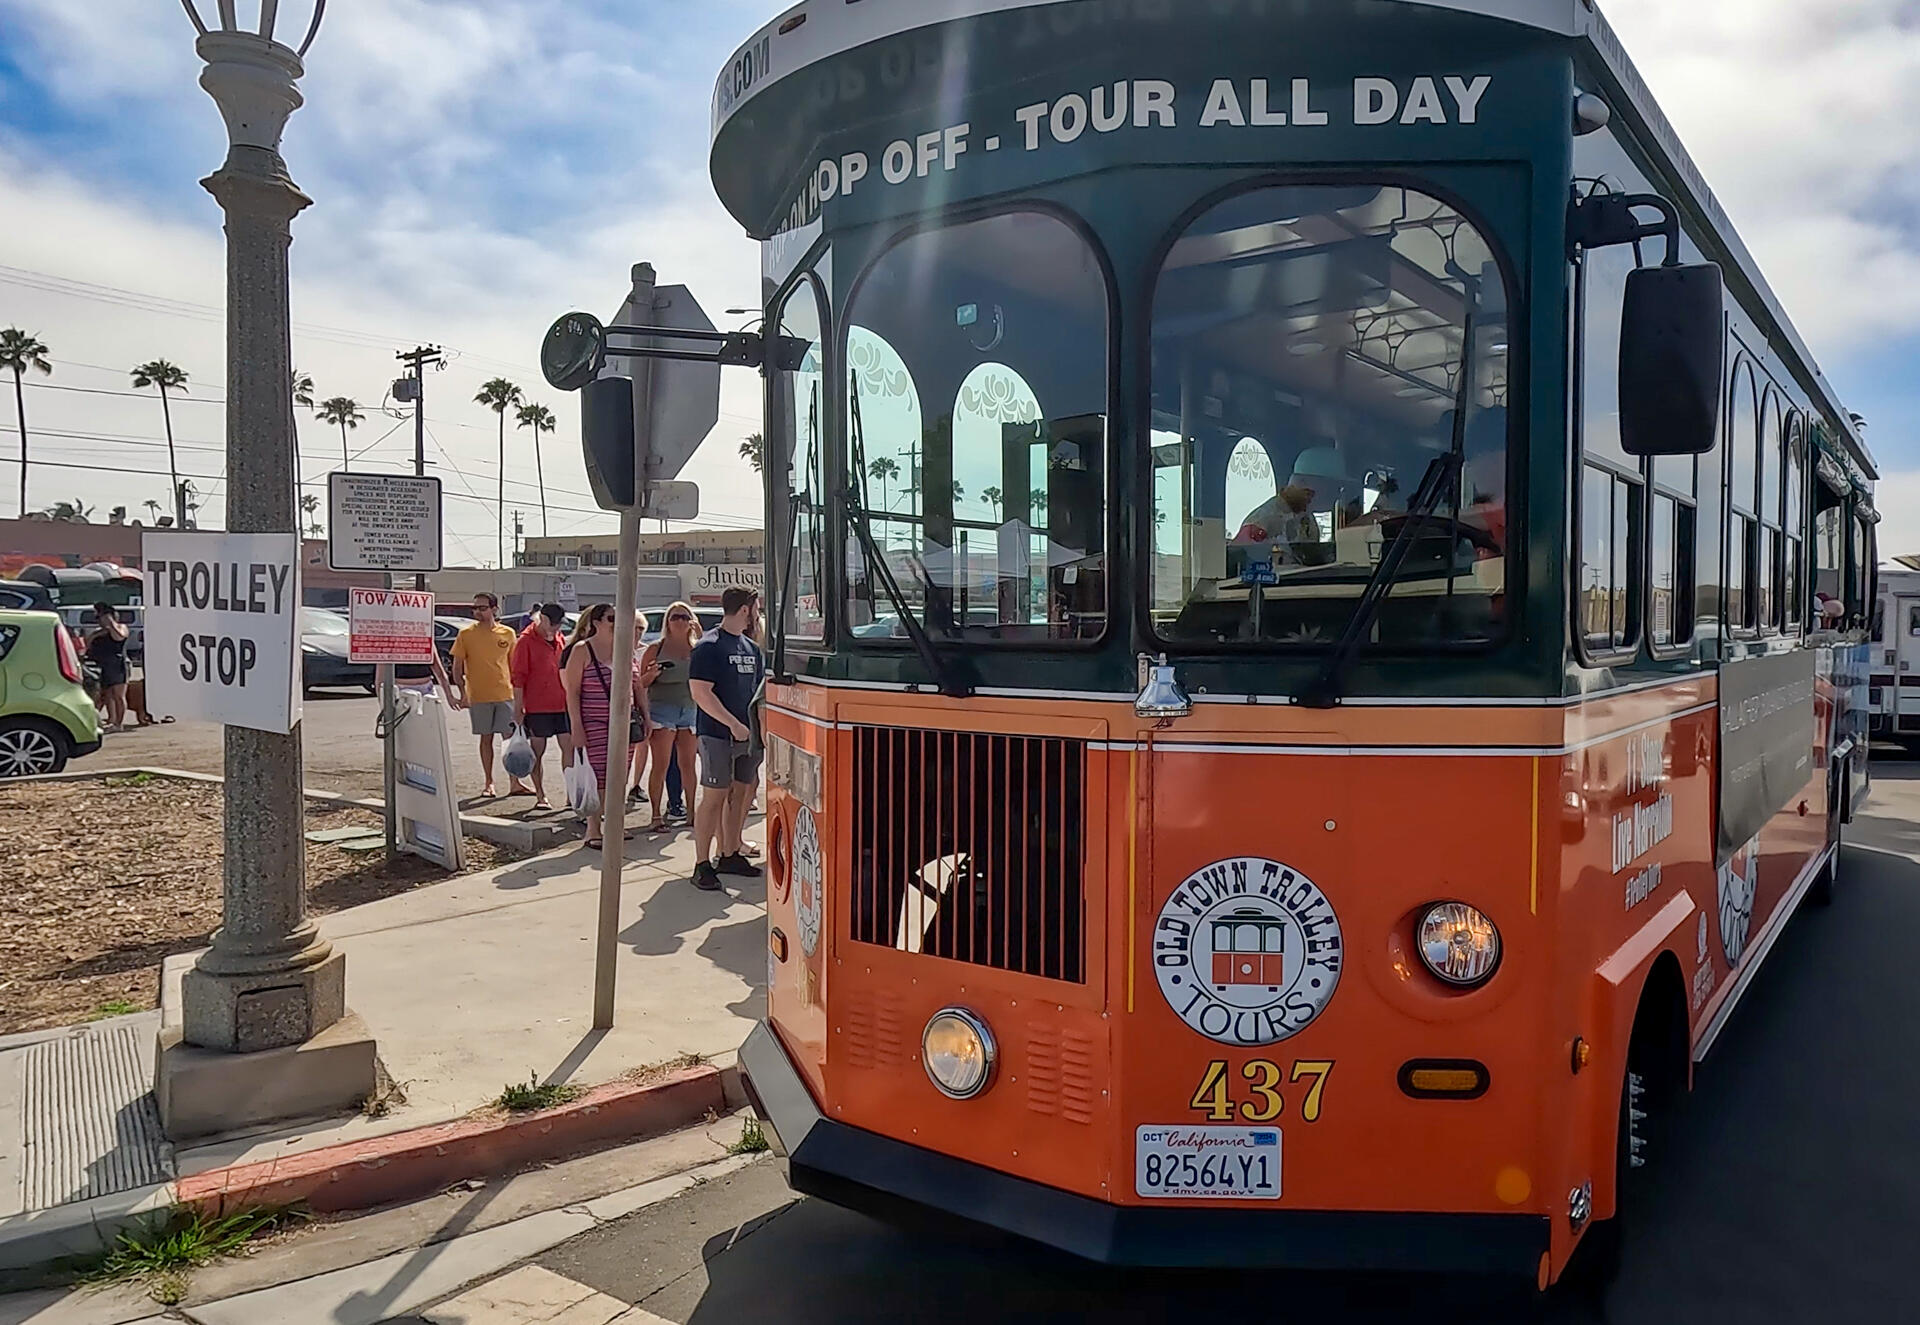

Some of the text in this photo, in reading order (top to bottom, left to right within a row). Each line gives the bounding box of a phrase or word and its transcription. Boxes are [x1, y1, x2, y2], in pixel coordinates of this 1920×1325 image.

[808, 152, 868, 216] HOP
[882, 122, 970, 185] OFF
[1015, 79, 1177, 151] TOUR
[1198, 78, 1329, 127] ALL
[1353, 76, 1492, 125] DAY
[147, 560, 290, 615] TROLLEY
[355, 592, 430, 608] TOW AWAY
[179, 633, 257, 687] STOP
[1626, 737, 1637, 796] 11
[1612, 811, 1632, 875] Live
[1156, 861, 1340, 972] OLD TOWN TROLLEY
[1180, 983, 1316, 1044] TOURS
[1190, 1058, 1336, 1123] 437
[1143, 1133, 1163, 1142] OCT
[1167, 1131, 1254, 1152] California
[1146, 1153, 1272, 1188] 82564Y1
[1172, 1188, 1245, 1196] dmv.ca.gov
